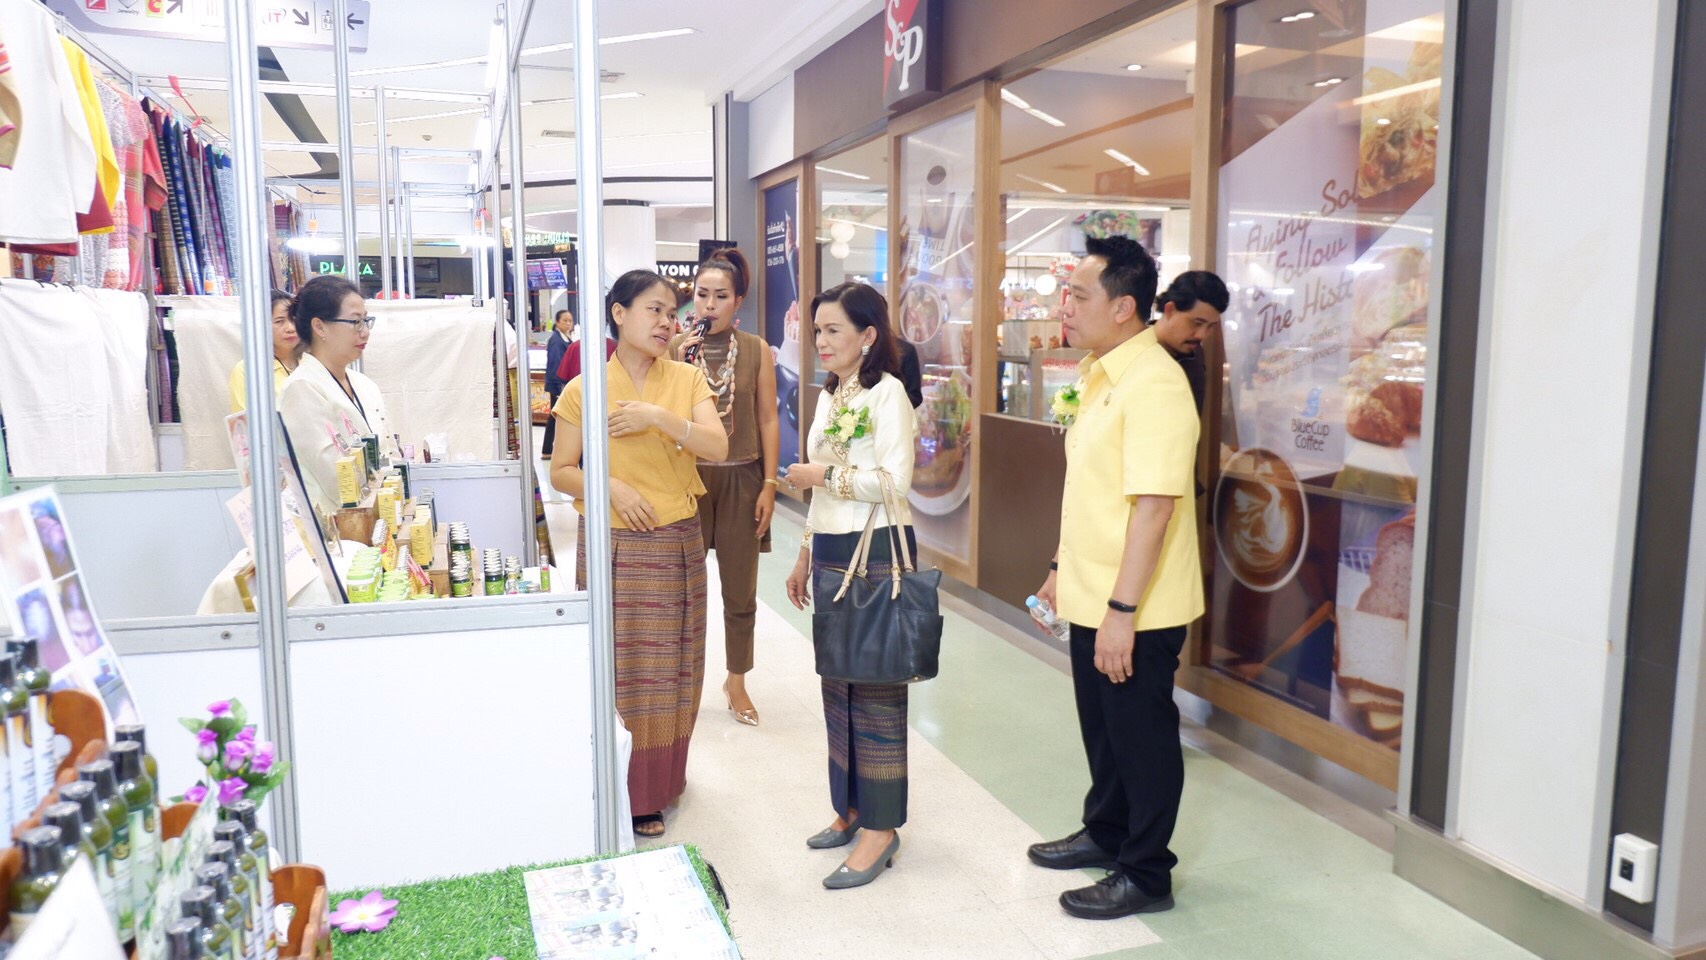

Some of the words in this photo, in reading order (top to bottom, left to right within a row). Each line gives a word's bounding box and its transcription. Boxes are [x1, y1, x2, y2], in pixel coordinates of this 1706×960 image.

[320, 261, 373, 275] PLA
[655, 264, 690, 277] YON
[1258, 301, 1296, 342] The
[1291, 418, 1330, 439] BlueCup
[1295, 434, 1324, 451] Coffee
